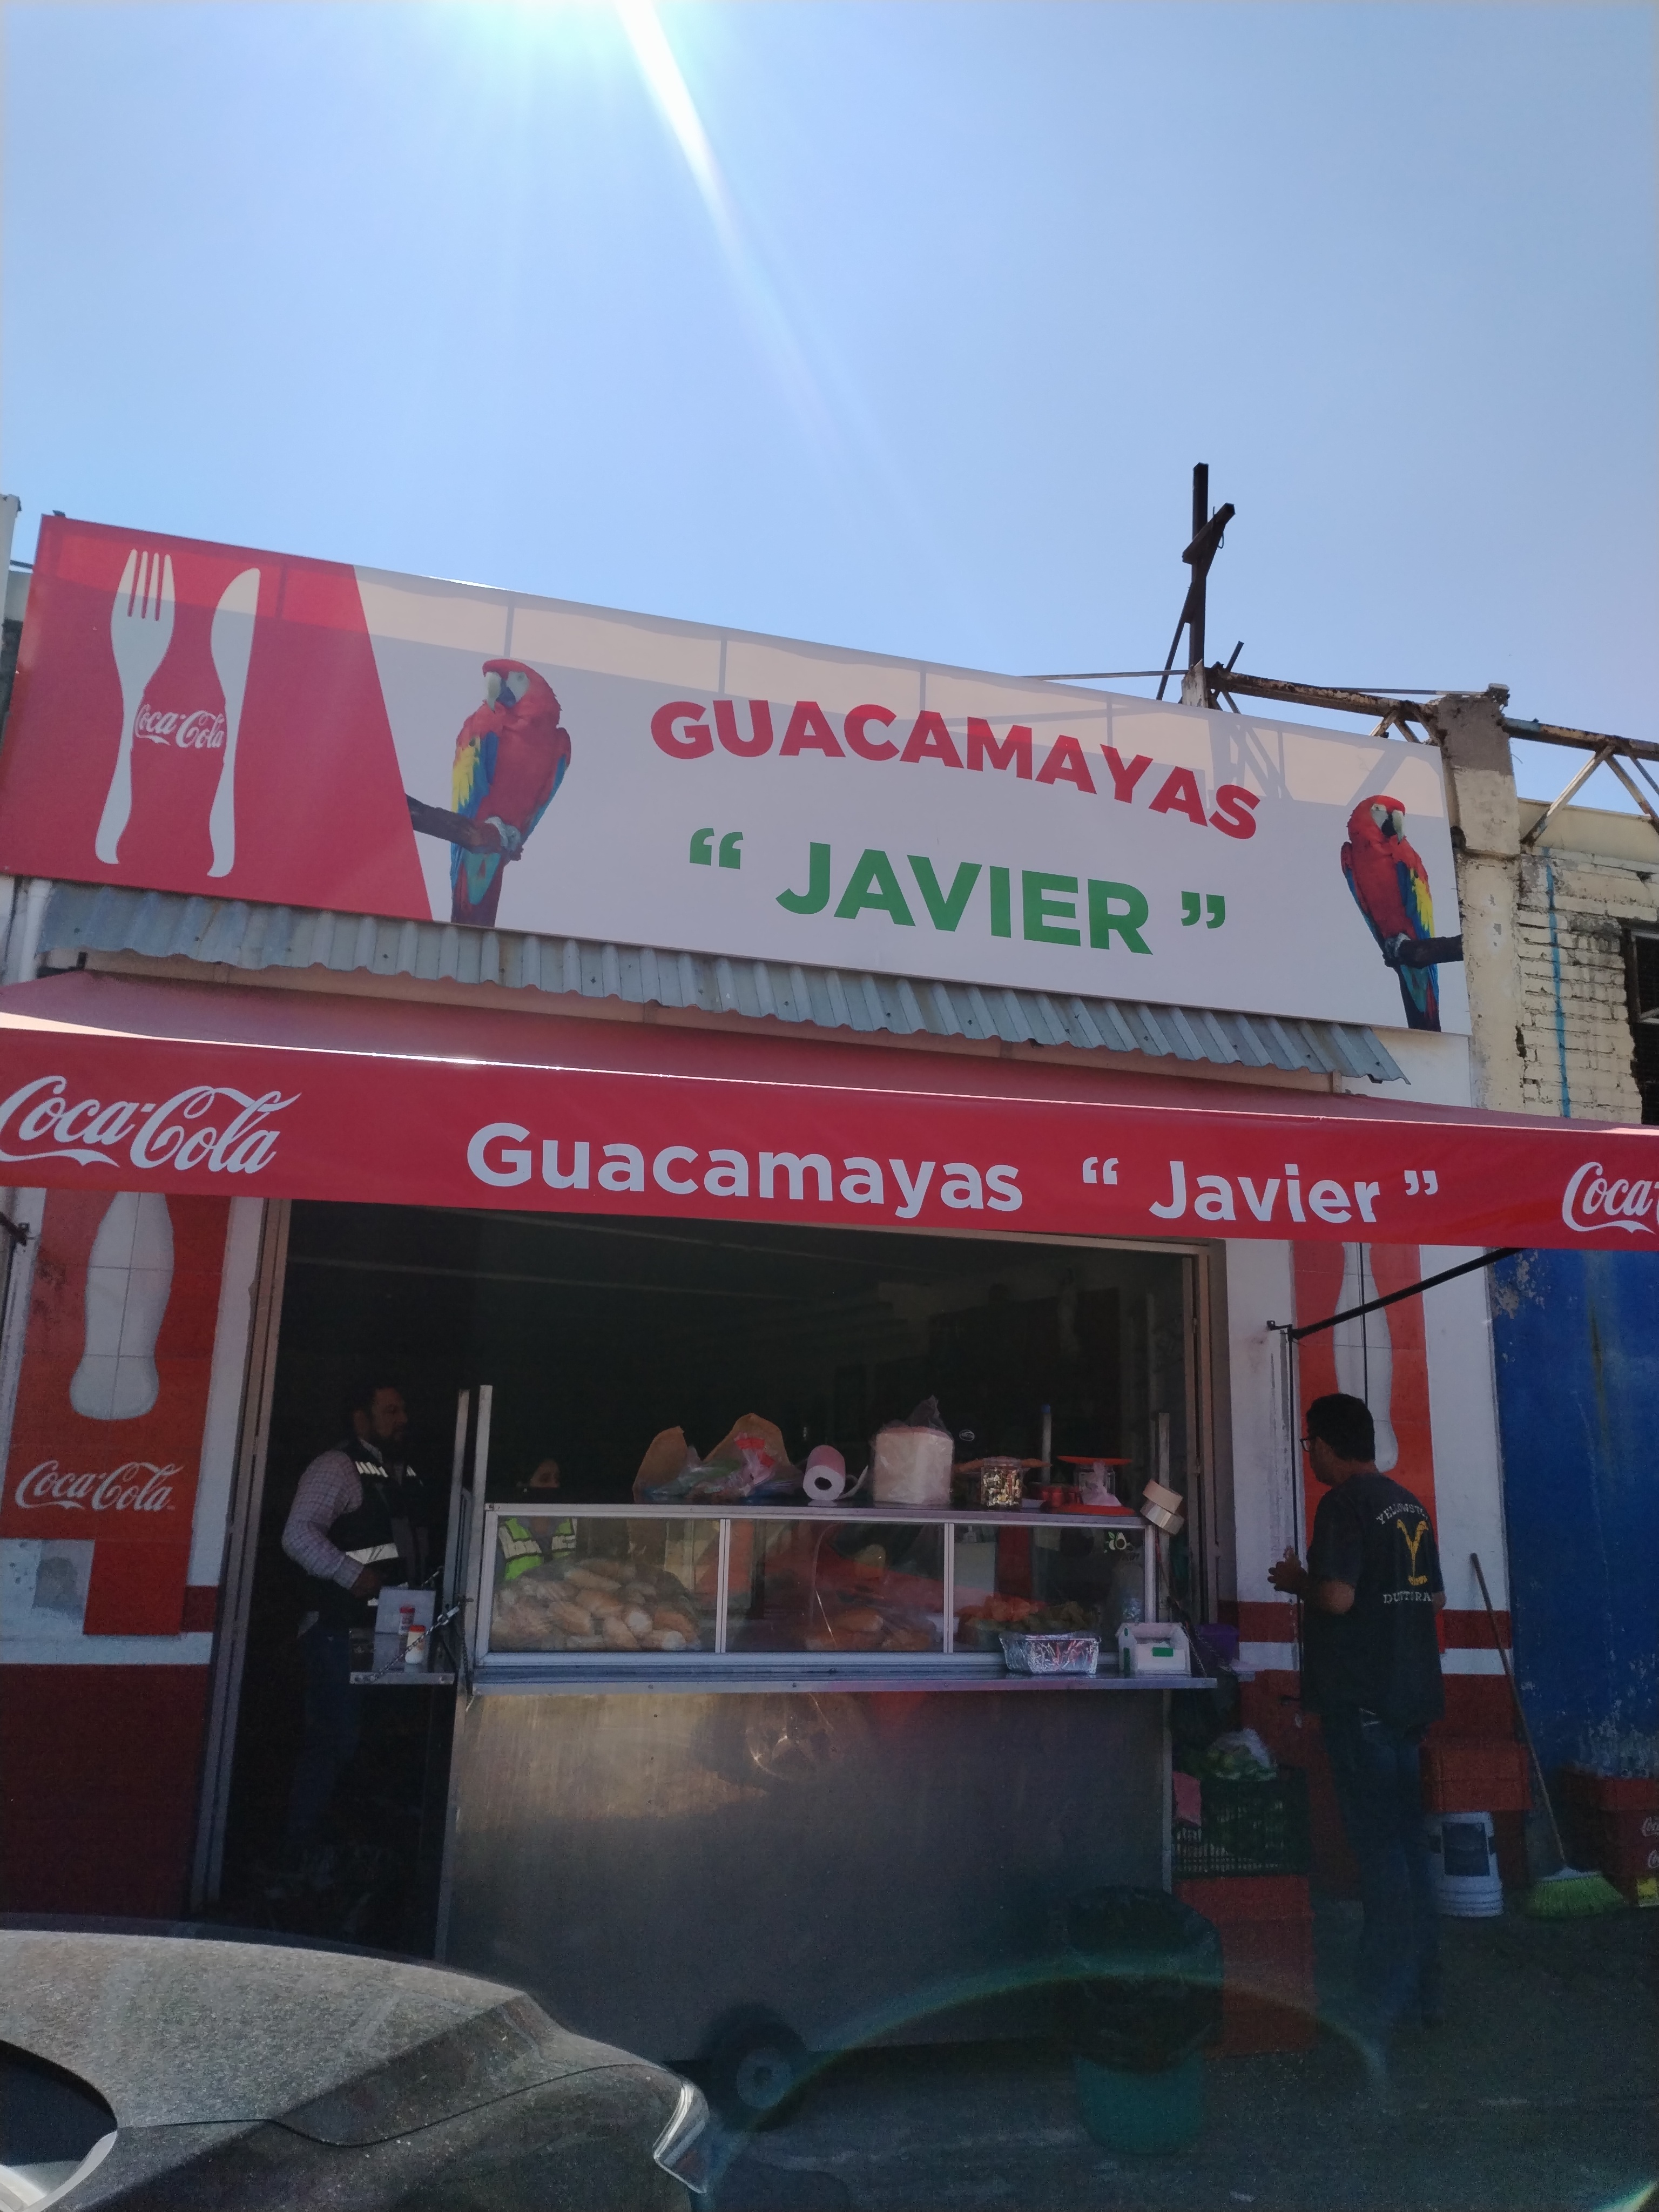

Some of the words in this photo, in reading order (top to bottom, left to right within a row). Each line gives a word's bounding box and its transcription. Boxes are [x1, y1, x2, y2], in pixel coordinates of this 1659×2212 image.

[134, 703, 225, 749] Coca-Cola
[650, 699, 1261, 840] GUACAMAYAS
[775, 841, 1153, 955] JAVIER
[0, 1075, 302, 1174] Coca-Cola
[467, 1122, 1023, 1218] Guacamayas
[1149, 1160, 1381, 1223] Javier
[15, 1460, 184, 1512] Coca-Cola
